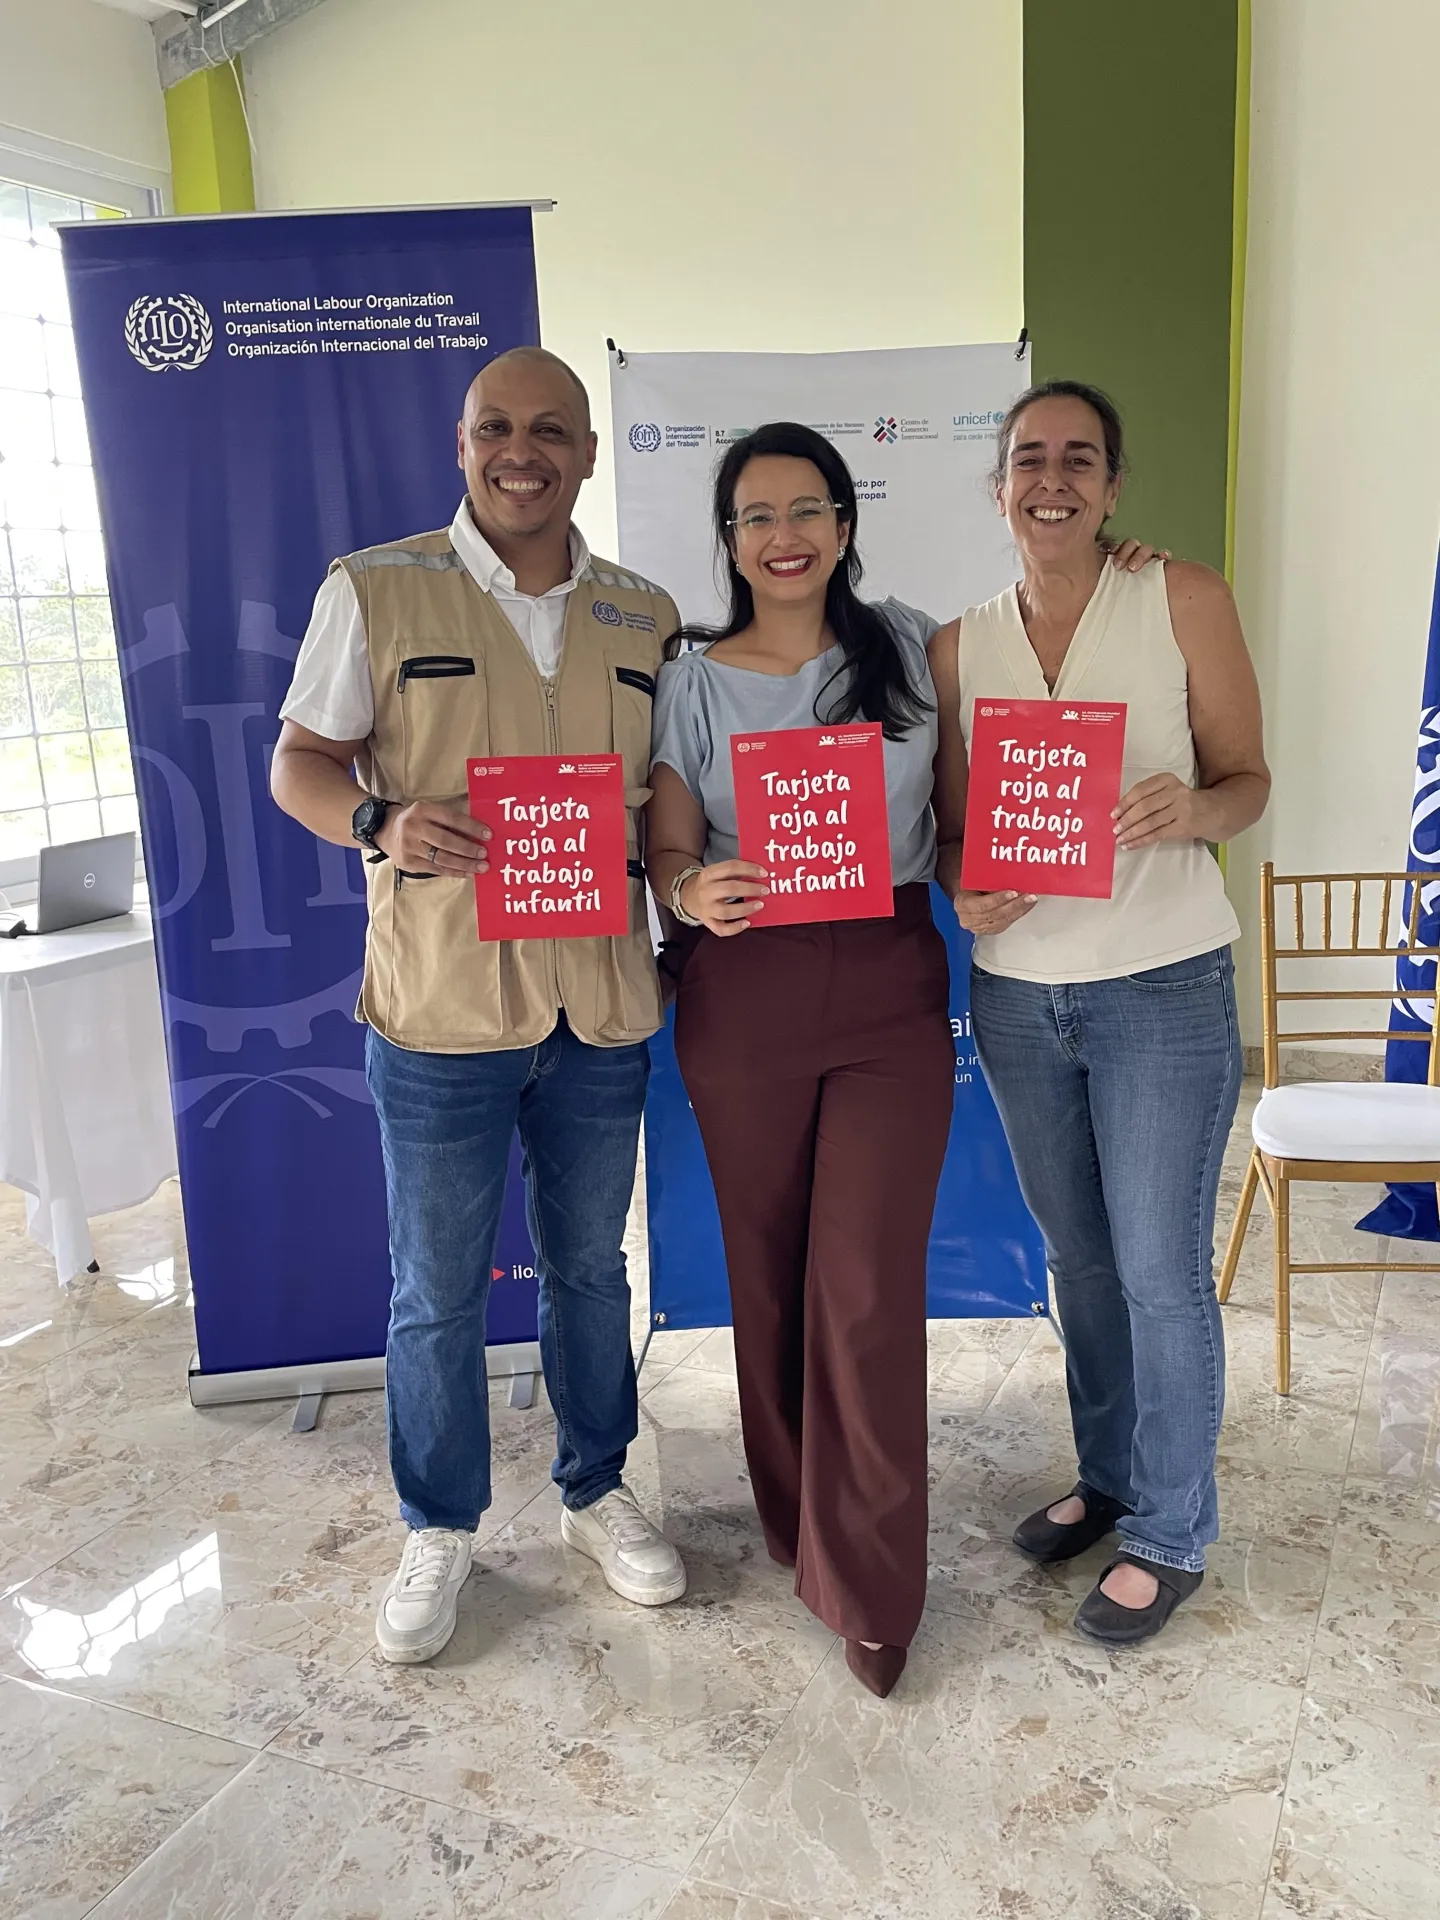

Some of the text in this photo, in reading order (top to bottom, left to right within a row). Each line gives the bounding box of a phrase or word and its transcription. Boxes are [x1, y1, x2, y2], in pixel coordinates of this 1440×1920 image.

[223, 292, 454, 314] International Labour Organization
[149, 310, 188, 347] ILO
[225, 312, 480, 337] Organisation internationale du Travail
[228, 333, 488, 359] Organización Internacional del Trabajo
[665, 425, 706, 434] Organización
[900, 418, 920, 426] Centro
[953, 411, 992, 426] unicef
[665, 432, 706, 440] Internacional
[665, 440, 700, 449] del Trabajo
[871, 480, 886, 489] por
[999, 739, 1087, 772] Tarjeta
[760, 769, 850, 801] Tarjeta
[1000, 773, 1081, 804] roja al
[497, 796, 590, 828] Tarjeta
[769, 800, 848, 835] roja al
[991, 805, 1083, 839] trabajo
[505, 828, 587, 860] roja al
[764, 833, 856, 864] trabajo
[991, 836, 1087, 866] infantil
[500, 861, 594, 889] trabajo
[769, 863, 865, 894] infantil
[505, 888, 601, 913] infantil
